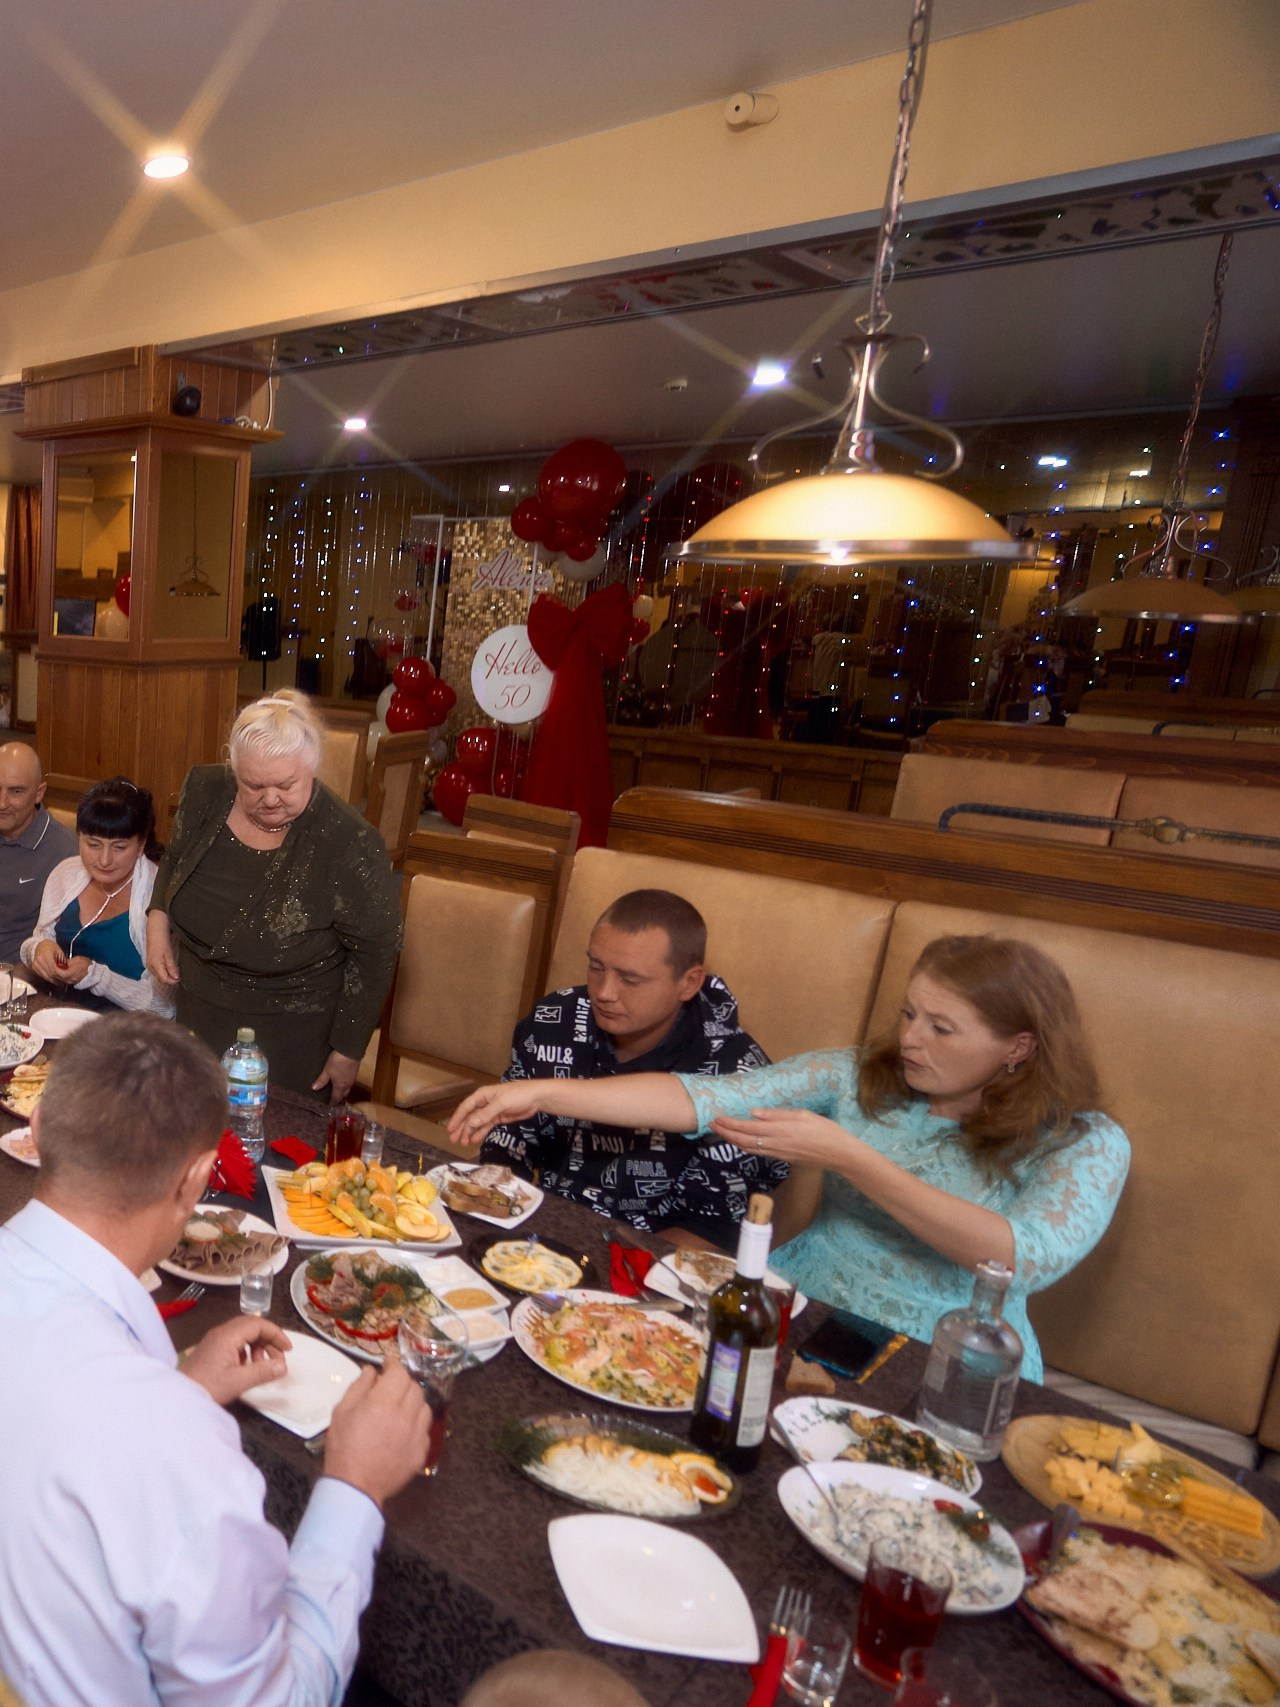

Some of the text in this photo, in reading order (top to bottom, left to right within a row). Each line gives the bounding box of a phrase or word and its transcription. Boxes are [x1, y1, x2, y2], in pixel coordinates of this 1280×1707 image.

[485, 640, 541, 680] Hello
[495, 684, 531, 710] 50
[626, 1160, 667, 1178] PAUL&
